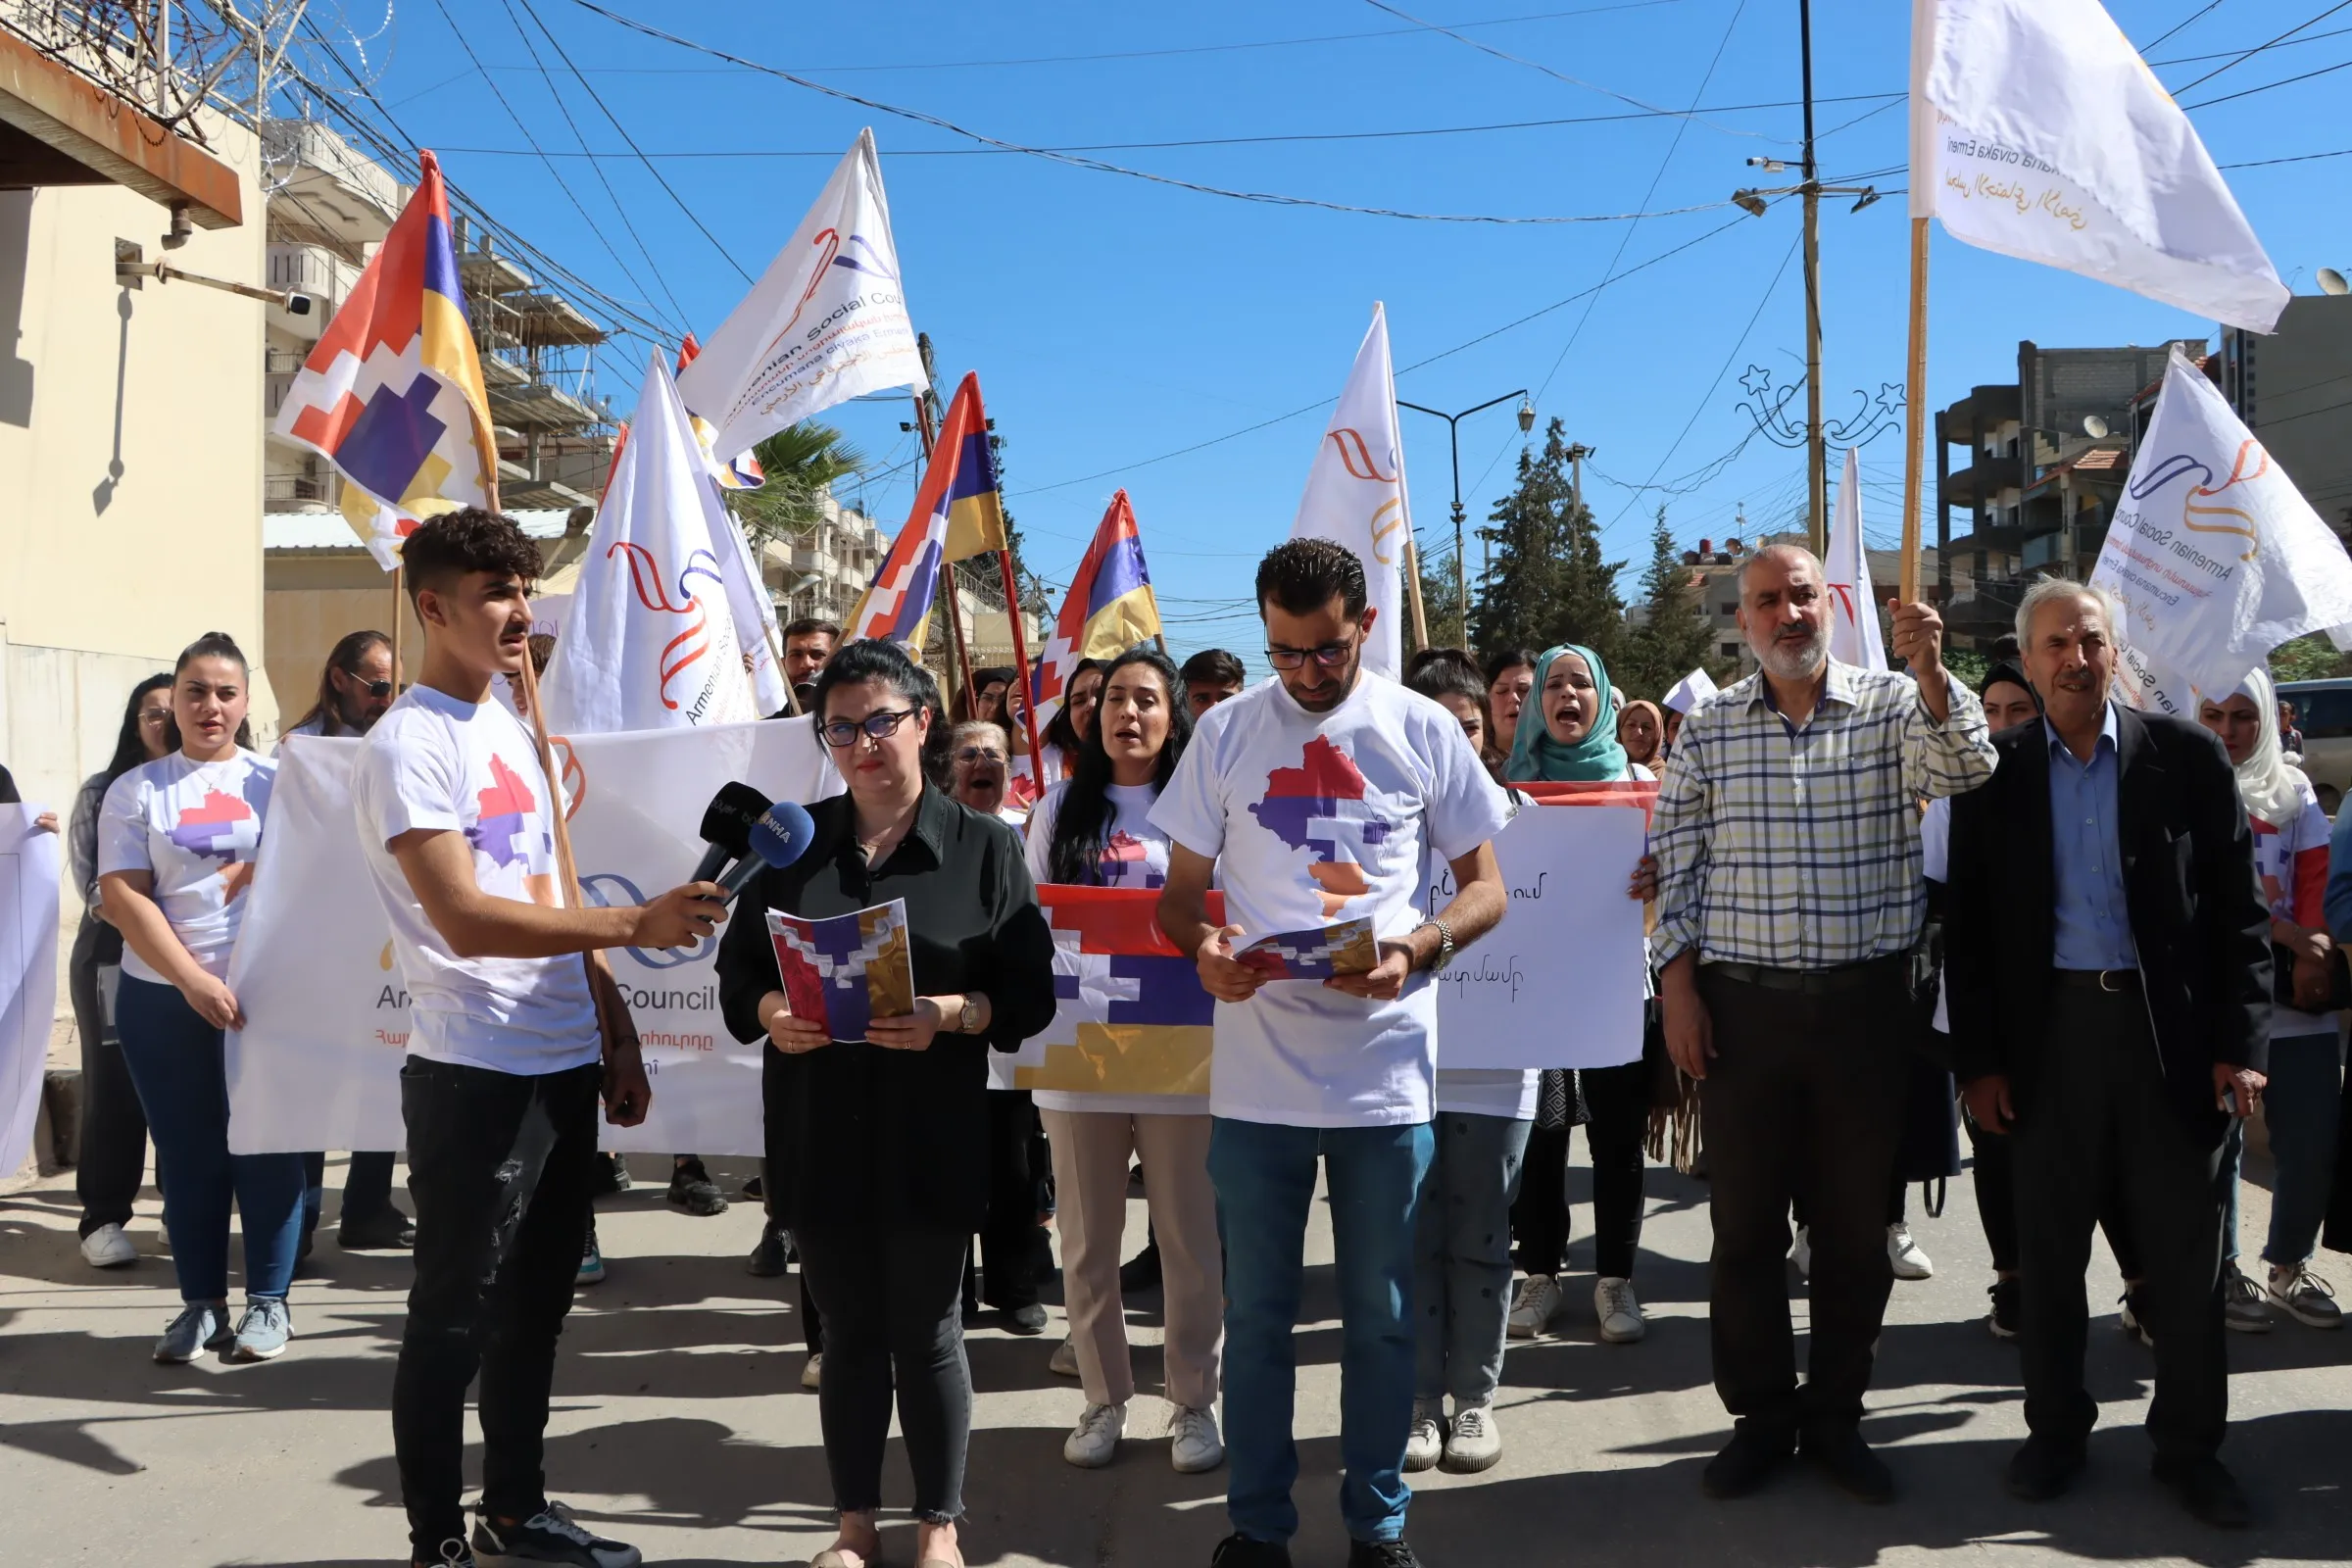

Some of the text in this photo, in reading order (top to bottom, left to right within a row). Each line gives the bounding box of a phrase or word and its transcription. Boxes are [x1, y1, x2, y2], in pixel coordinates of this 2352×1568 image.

[807, 295, 866, 342] Social
[685, 655, 723, 727] Armenian
[616, 983, 714, 1010] Council
[640, 1029, 713, 1052] րհուրդը
